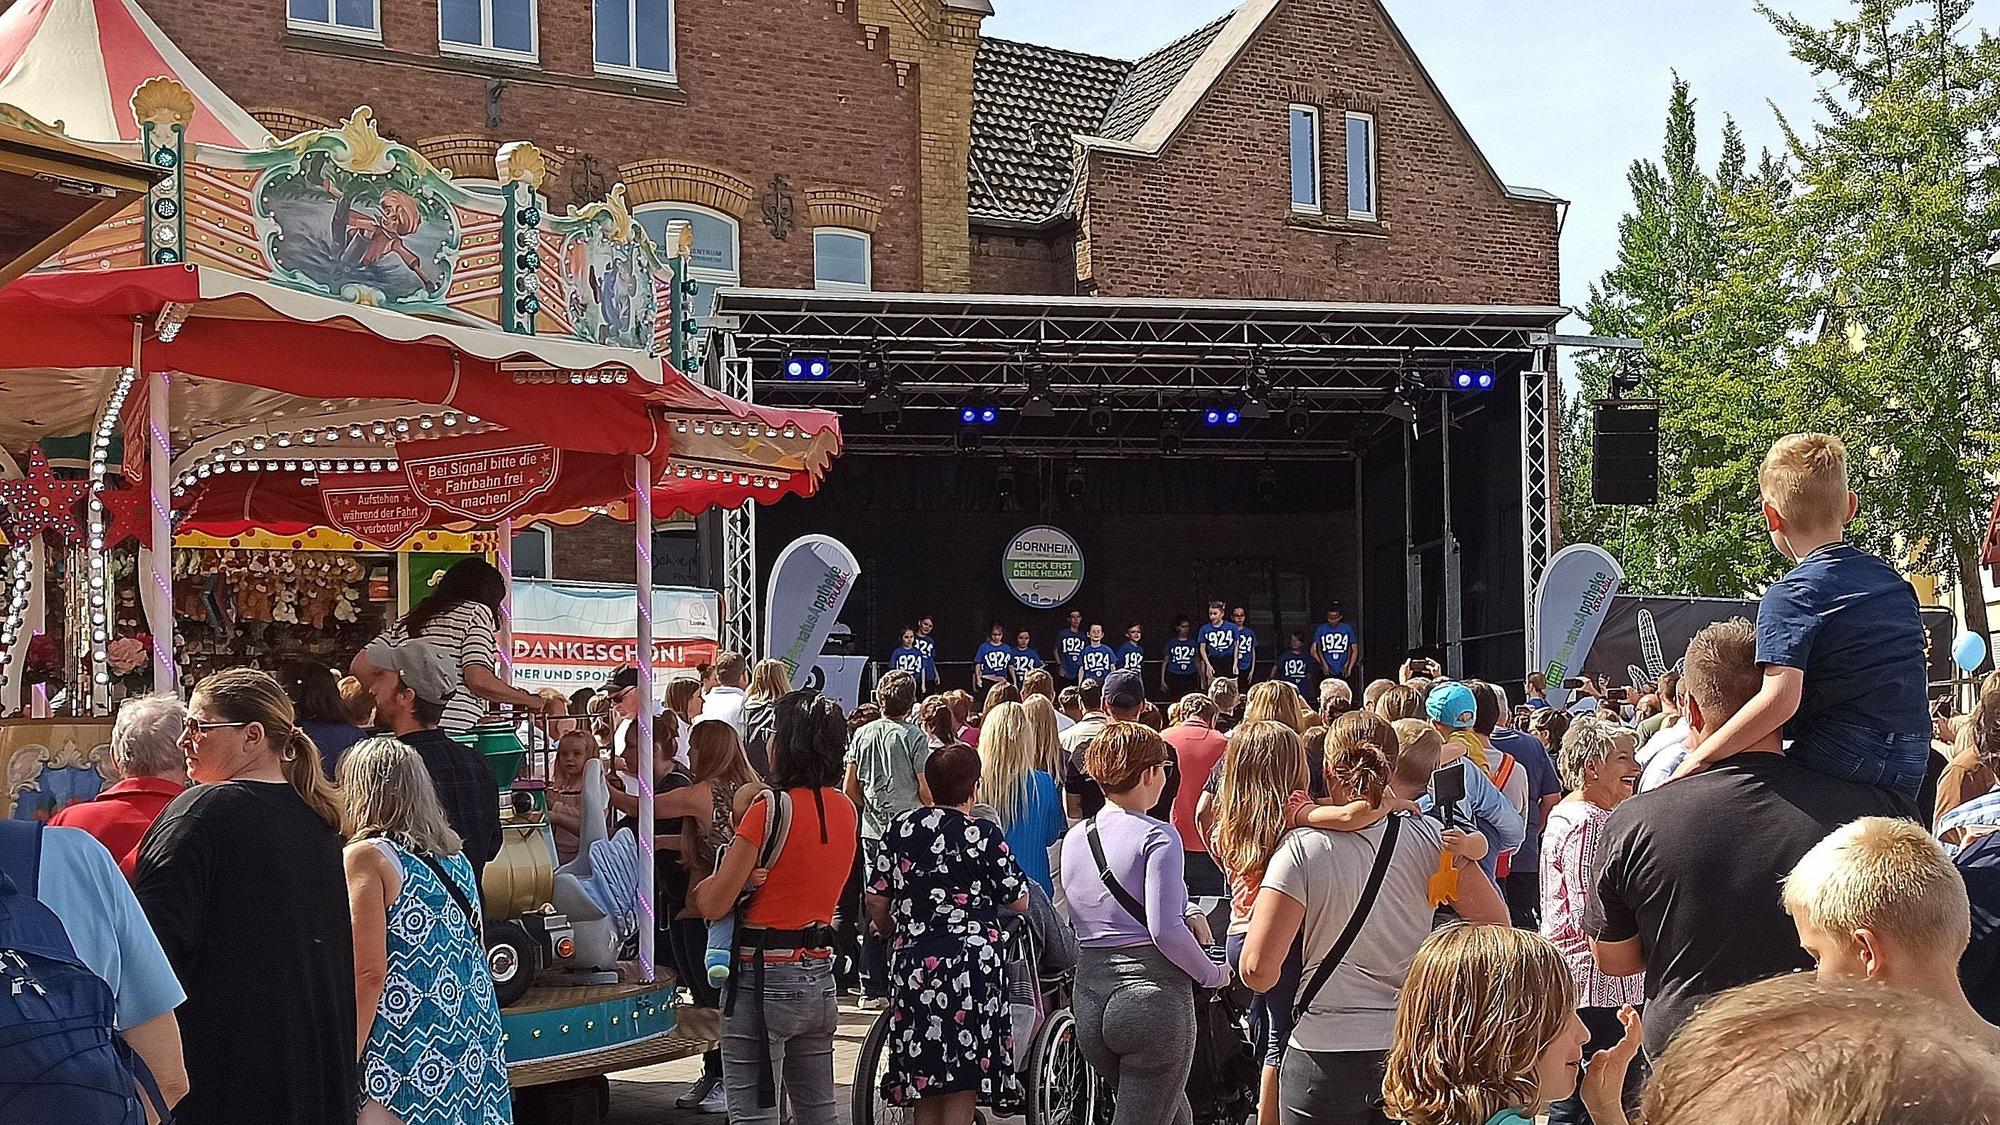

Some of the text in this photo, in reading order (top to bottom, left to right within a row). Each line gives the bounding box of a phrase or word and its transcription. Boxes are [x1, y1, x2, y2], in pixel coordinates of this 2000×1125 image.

[428, 453, 537, 478] Bei Signal bitte die
[445, 471, 523, 493] Fahrbahn frei
[358, 493, 400, 505] Aufstehen
[461, 490, 511, 508] machen!
[342, 506, 418, 520] während der Fahrt
[362, 521, 402, 534] verboten!
[1015, 540, 1073, 554] BORNHEIM
[1013, 561, 1073, 570] #CHECK ERST
[1013, 569, 1039, 577] DEINE
[1205, 630, 1233, 648] 1924
[1239, 635, 1253, 652] 24
[1321, 633, 1348, 651] 1924
[985, 651, 1011, 668] 1924
[1084, 652, 1109, 670] 1924
[1124, 652, 1143, 668] 192
[1171, 646, 1195, 662] 1924
[896, 655, 922, 672] 1924
[514, 669, 540, 679] NER
[544, 669, 572, 680] UND
